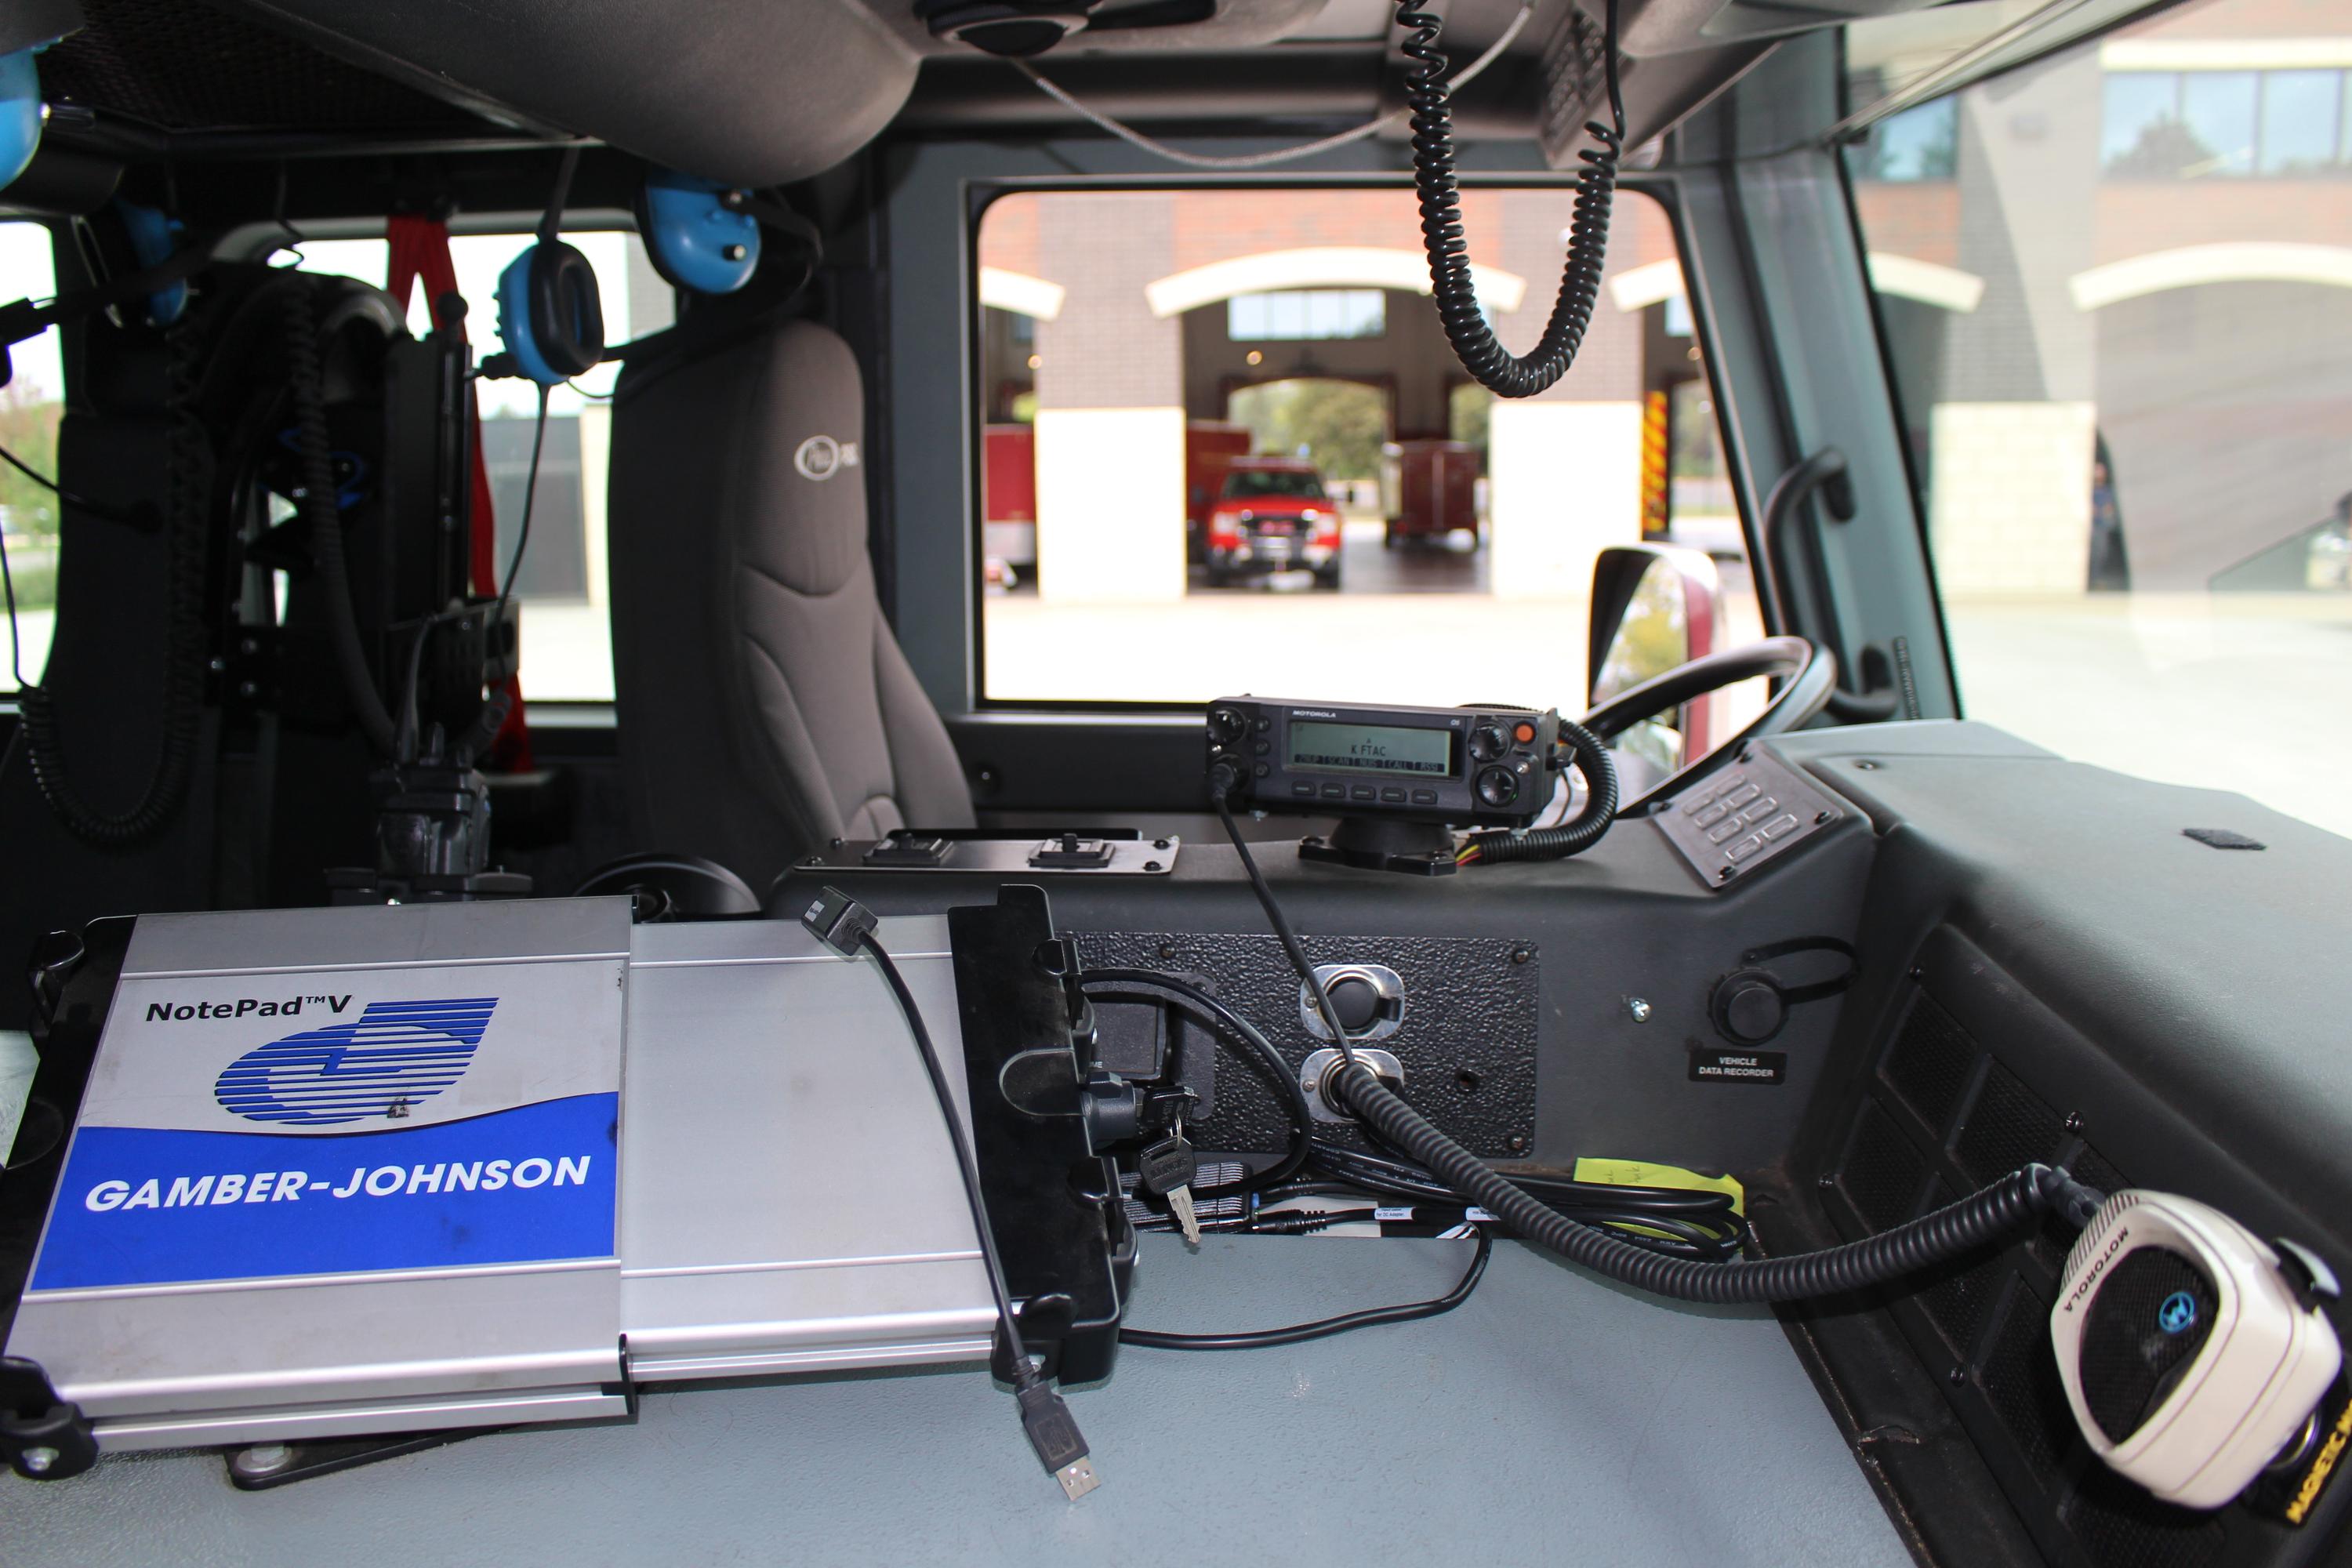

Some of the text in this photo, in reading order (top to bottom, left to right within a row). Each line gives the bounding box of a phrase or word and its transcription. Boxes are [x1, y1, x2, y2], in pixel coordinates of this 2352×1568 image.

[1361, 745, 1386, 757] FTAC
[1719, 1057, 1757, 1065] VEHICLE
[1698, 1066, 1773, 1077] DATA RECORDER
[85, 1156, 590, 1211] GAMBER-JOHNSON
[2063, 1226, 2129, 1312] MOTOROLA
